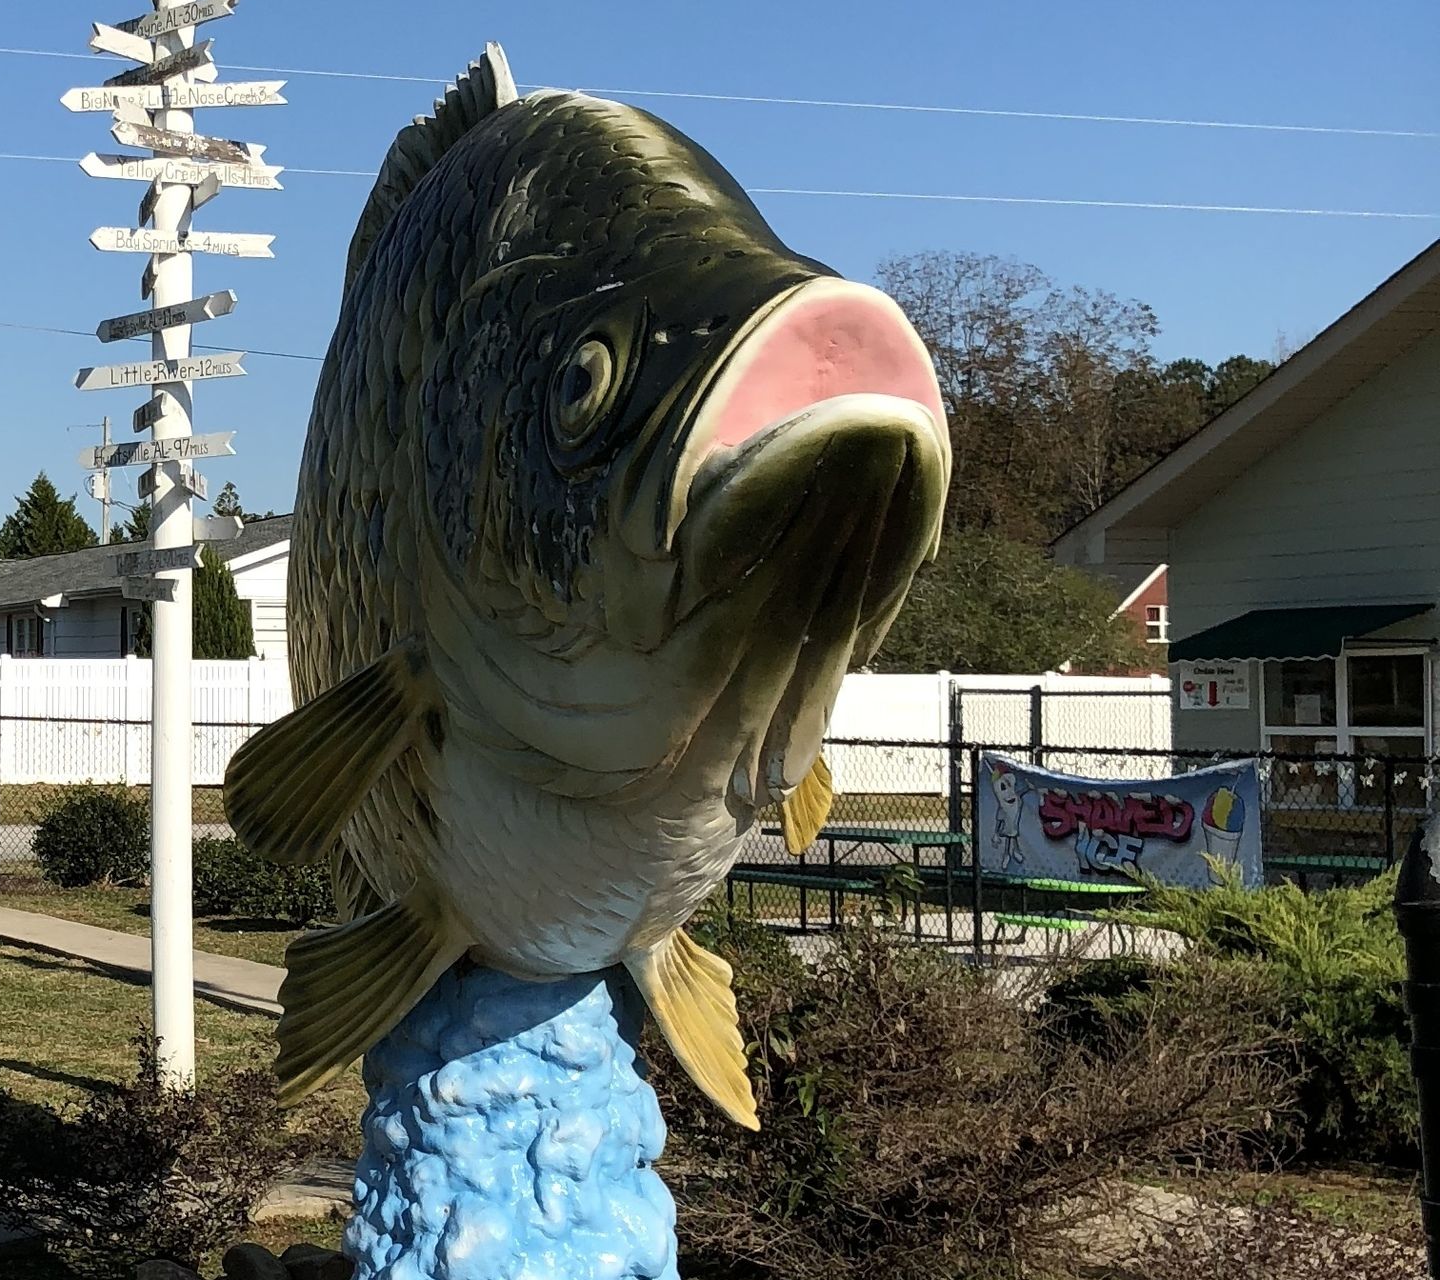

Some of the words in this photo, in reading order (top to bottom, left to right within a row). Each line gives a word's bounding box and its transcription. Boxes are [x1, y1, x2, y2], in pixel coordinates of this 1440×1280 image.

[81, 91, 103, 110] Big
[188, 88, 224, 105] Nose
[165, 161, 204, 182] Creek
[115, 230, 140, 250] Bay
[212, 242, 240, 255] MILES
[110, 366, 152, 385] Little
[1038, 788, 1195, 843] SHAVED
[1074, 824, 1146, 875] ICE
